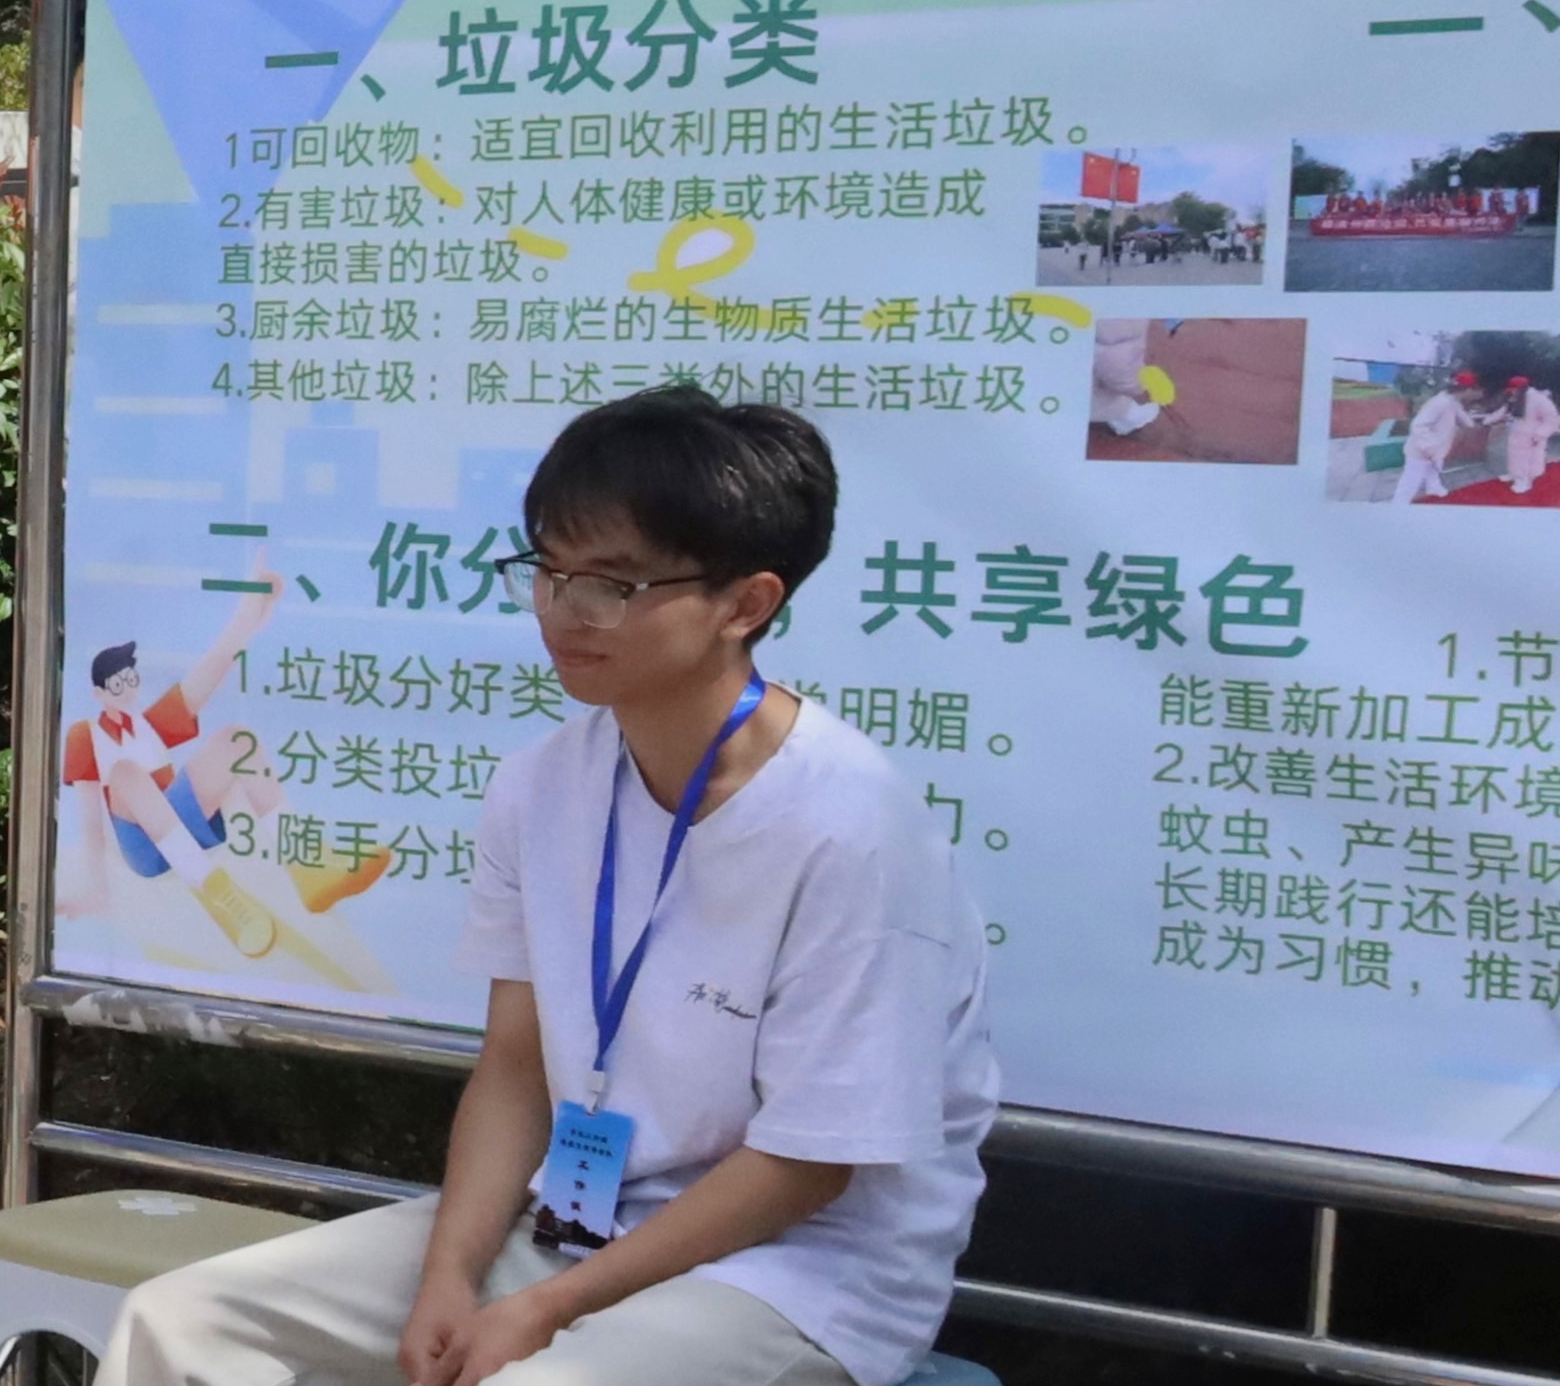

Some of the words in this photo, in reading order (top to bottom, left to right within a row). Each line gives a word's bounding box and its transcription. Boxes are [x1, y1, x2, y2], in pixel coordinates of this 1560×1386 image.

[217, 240, 549, 286] 直接损害的垃圾。
[1438, 630, 1559, 687] 1.节
[1160, 673, 1556, 753] 能重新加工成
